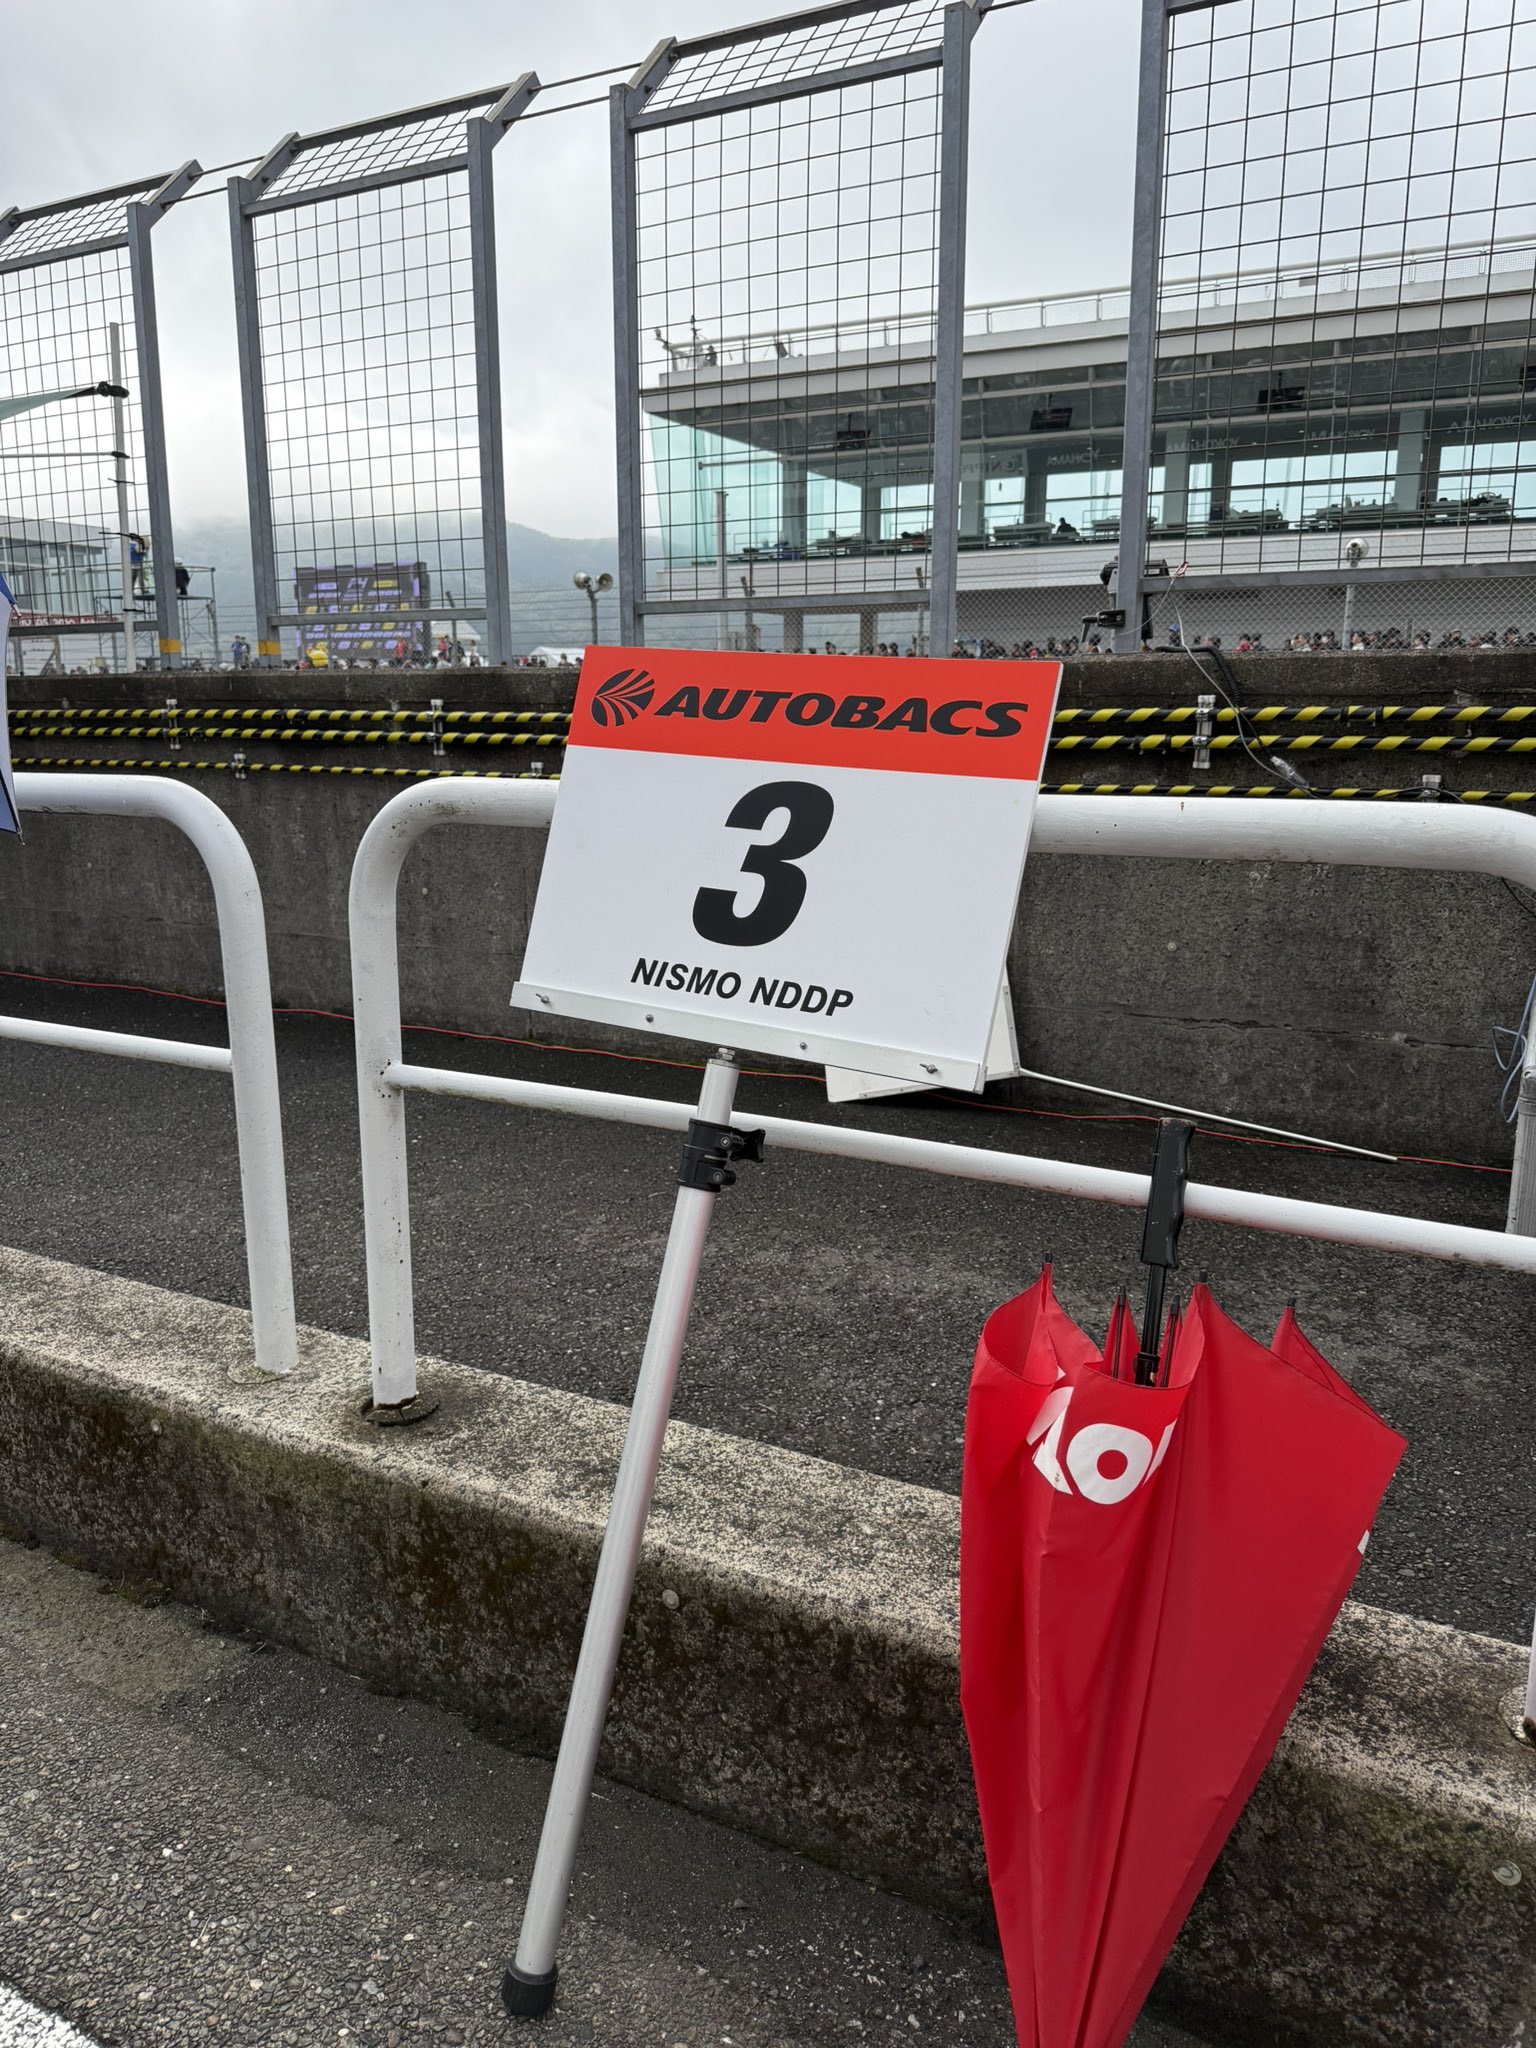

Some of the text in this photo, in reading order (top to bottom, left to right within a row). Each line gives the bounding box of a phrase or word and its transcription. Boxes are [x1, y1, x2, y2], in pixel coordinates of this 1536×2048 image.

[656, 686, 1028, 737] AUTOBACS
[692, 781, 835, 947] 3
[630, 958, 854, 1017] NISMO NDDP
